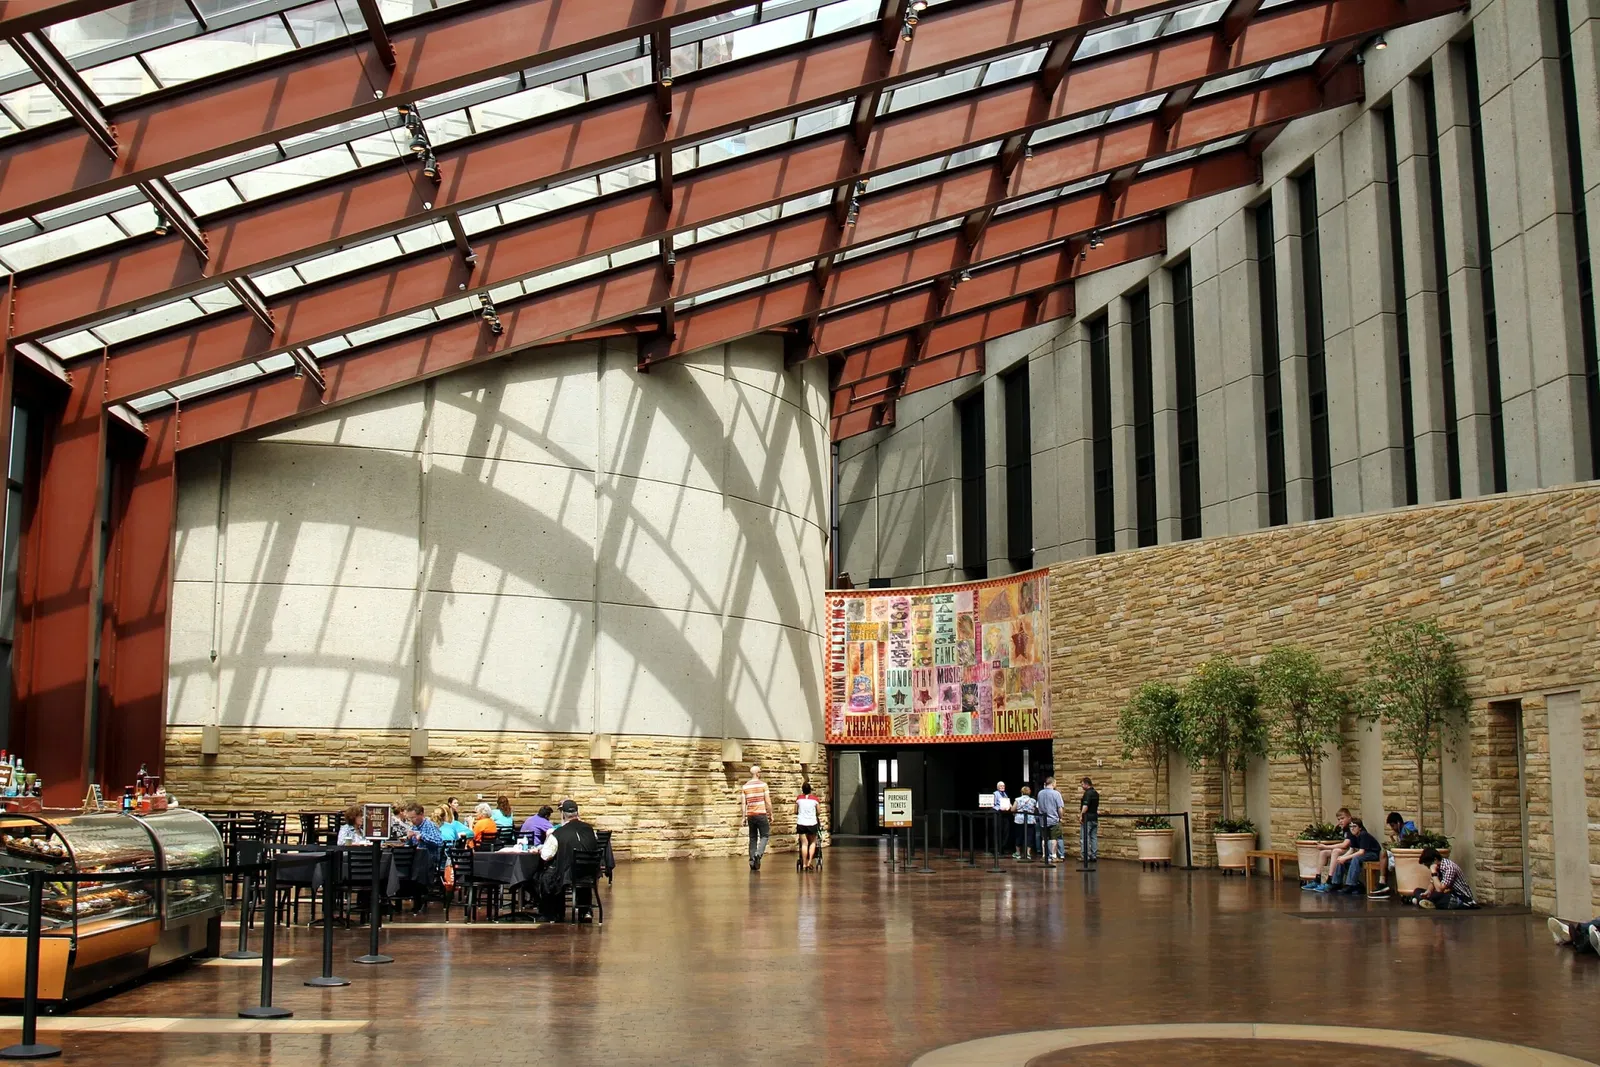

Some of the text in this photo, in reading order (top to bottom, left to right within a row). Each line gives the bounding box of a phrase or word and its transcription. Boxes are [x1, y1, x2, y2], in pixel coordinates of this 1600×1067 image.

[831, 599, 846, 673] WILLIAMS
[935, 645, 956, 664] FAME
[887, 670, 912, 687] HONOR
[915, 670, 932, 687] THY
[937, 666, 961, 684] MUSIC
[832, 676, 846, 703] HANK
[845, 715, 891, 737] THEATER
[996, 708, 1039, 733] TICKETS
